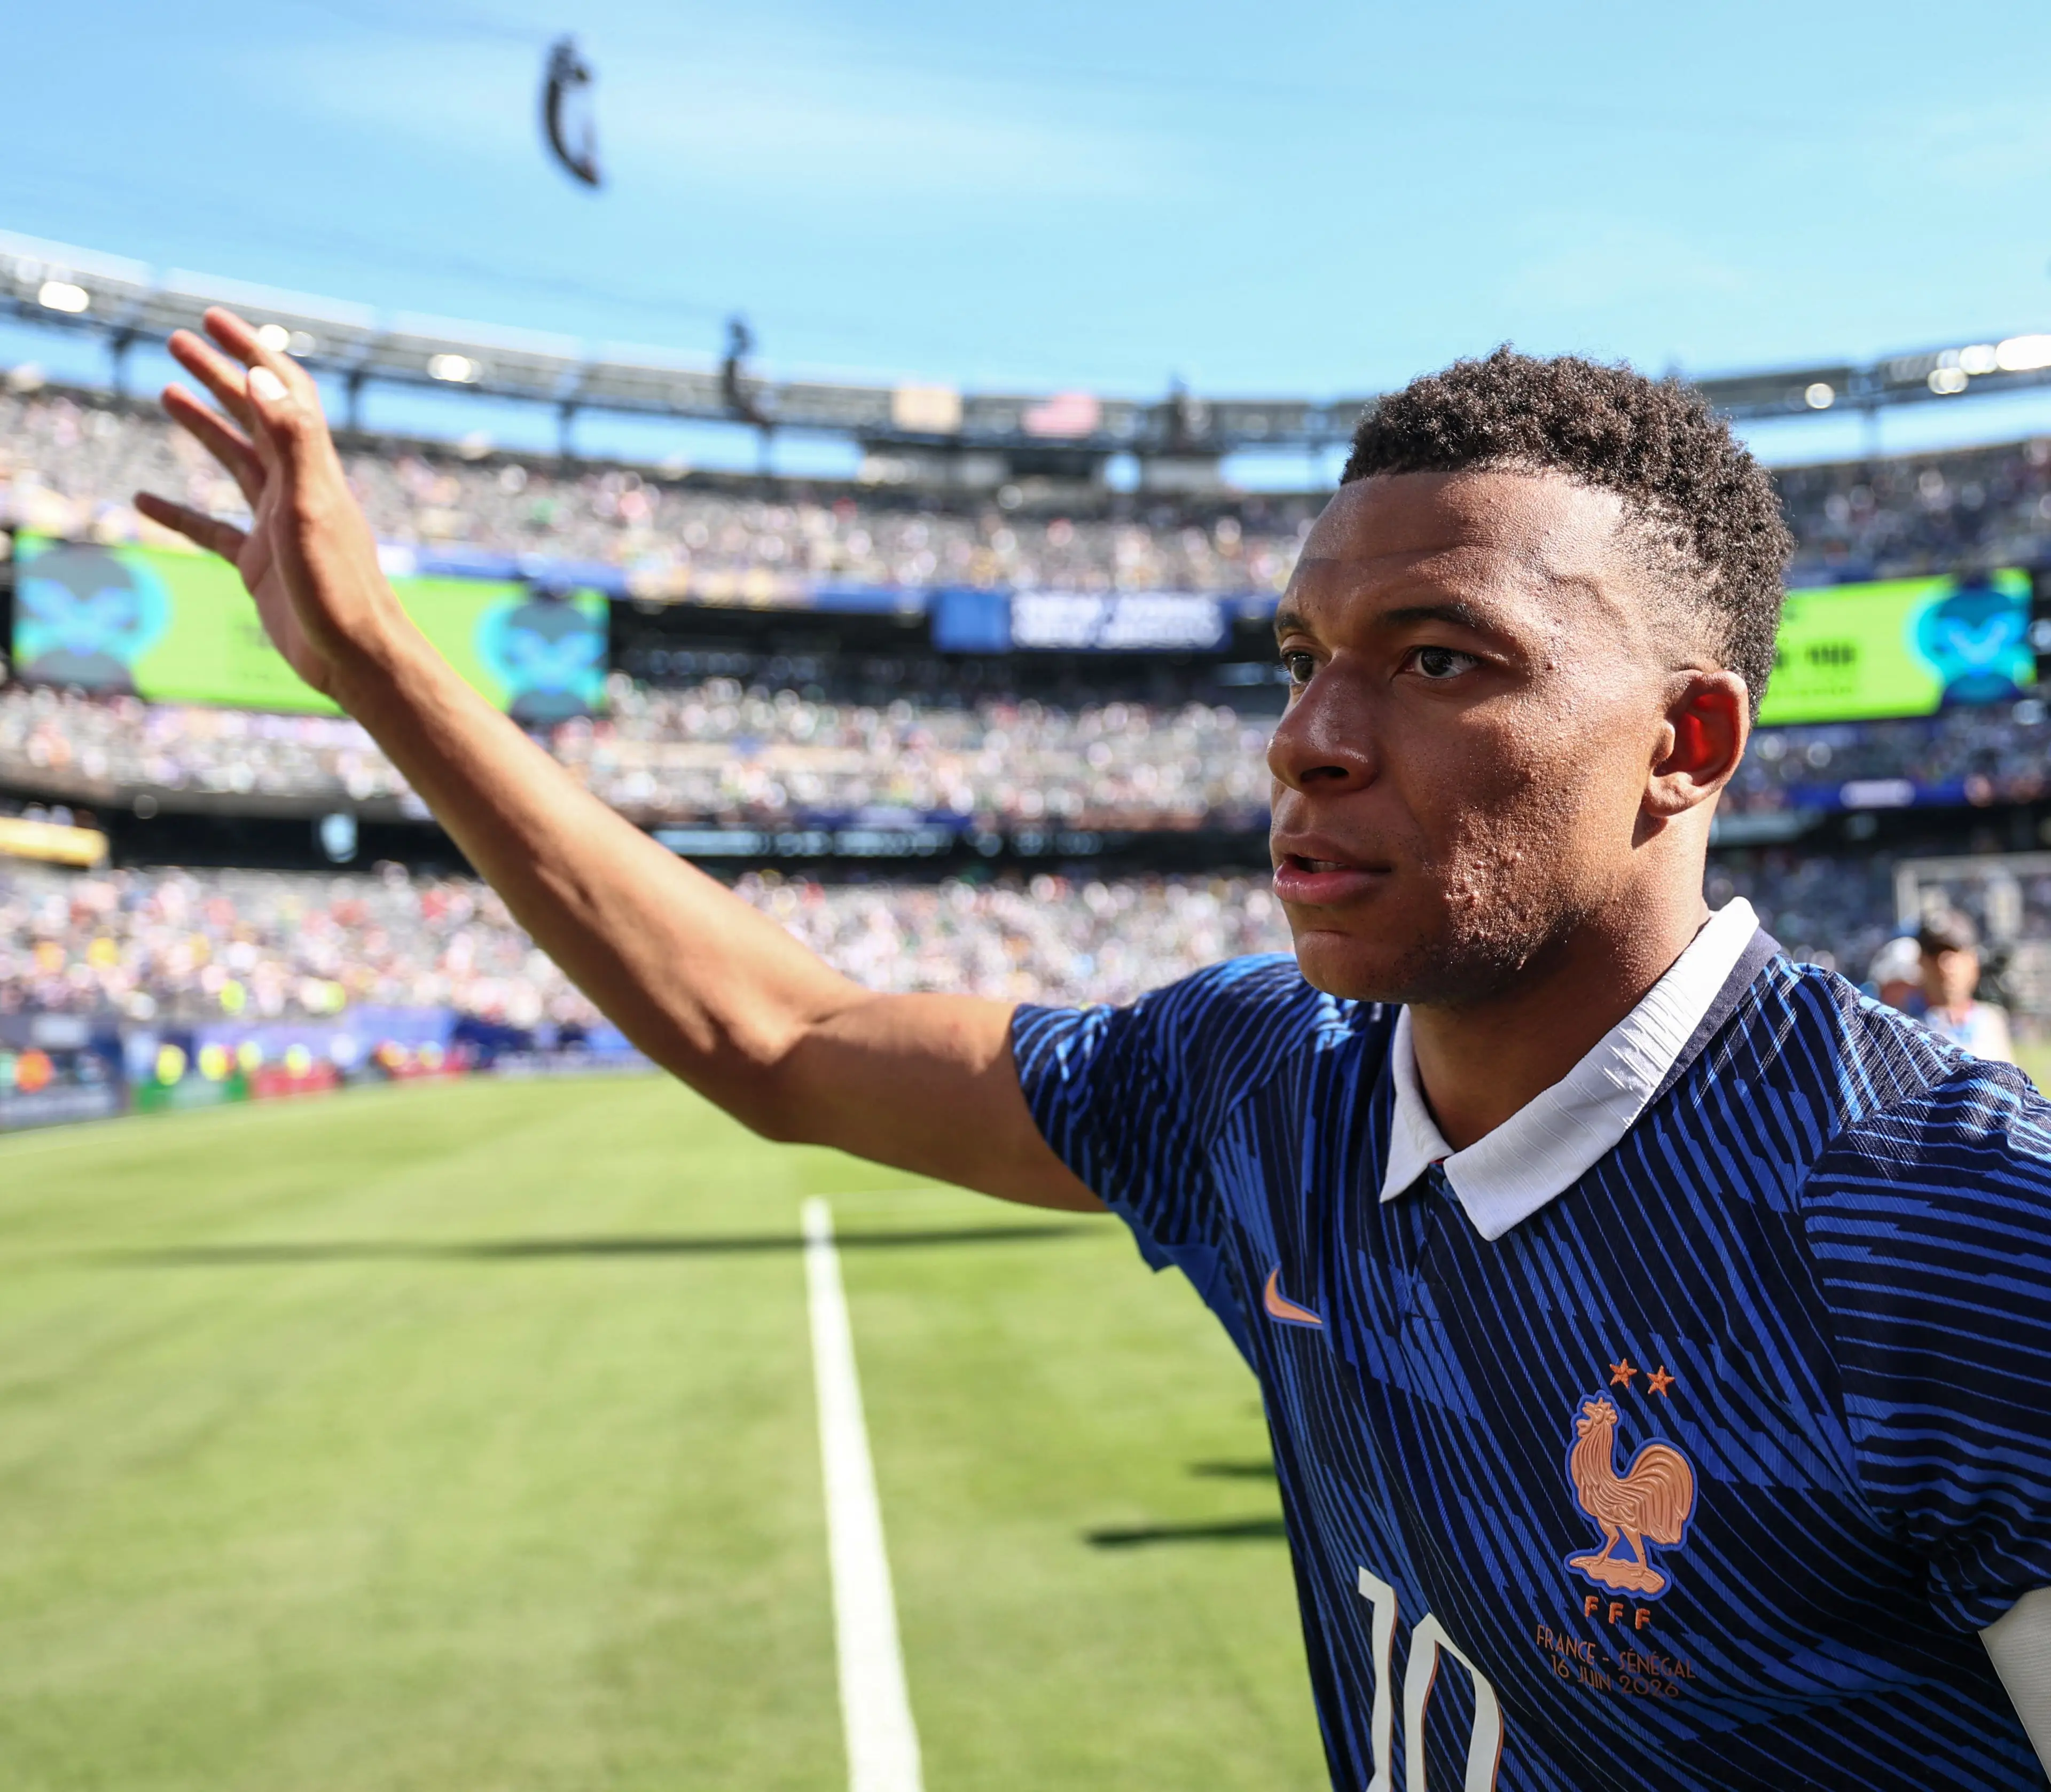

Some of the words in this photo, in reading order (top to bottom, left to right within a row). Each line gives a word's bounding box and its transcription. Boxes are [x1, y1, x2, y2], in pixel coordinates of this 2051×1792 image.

[1358, 1566, 1504, 1792] 10
[1536, 1624, 1596, 1665] FRANCE
[1618, 1648, 1696, 1679] SÉNÉGAL
[1551, 1654, 1570, 1678] 16
[1577, 1665, 1611, 1692] JUIN
[1619, 1675, 1679, 1698] 2026
